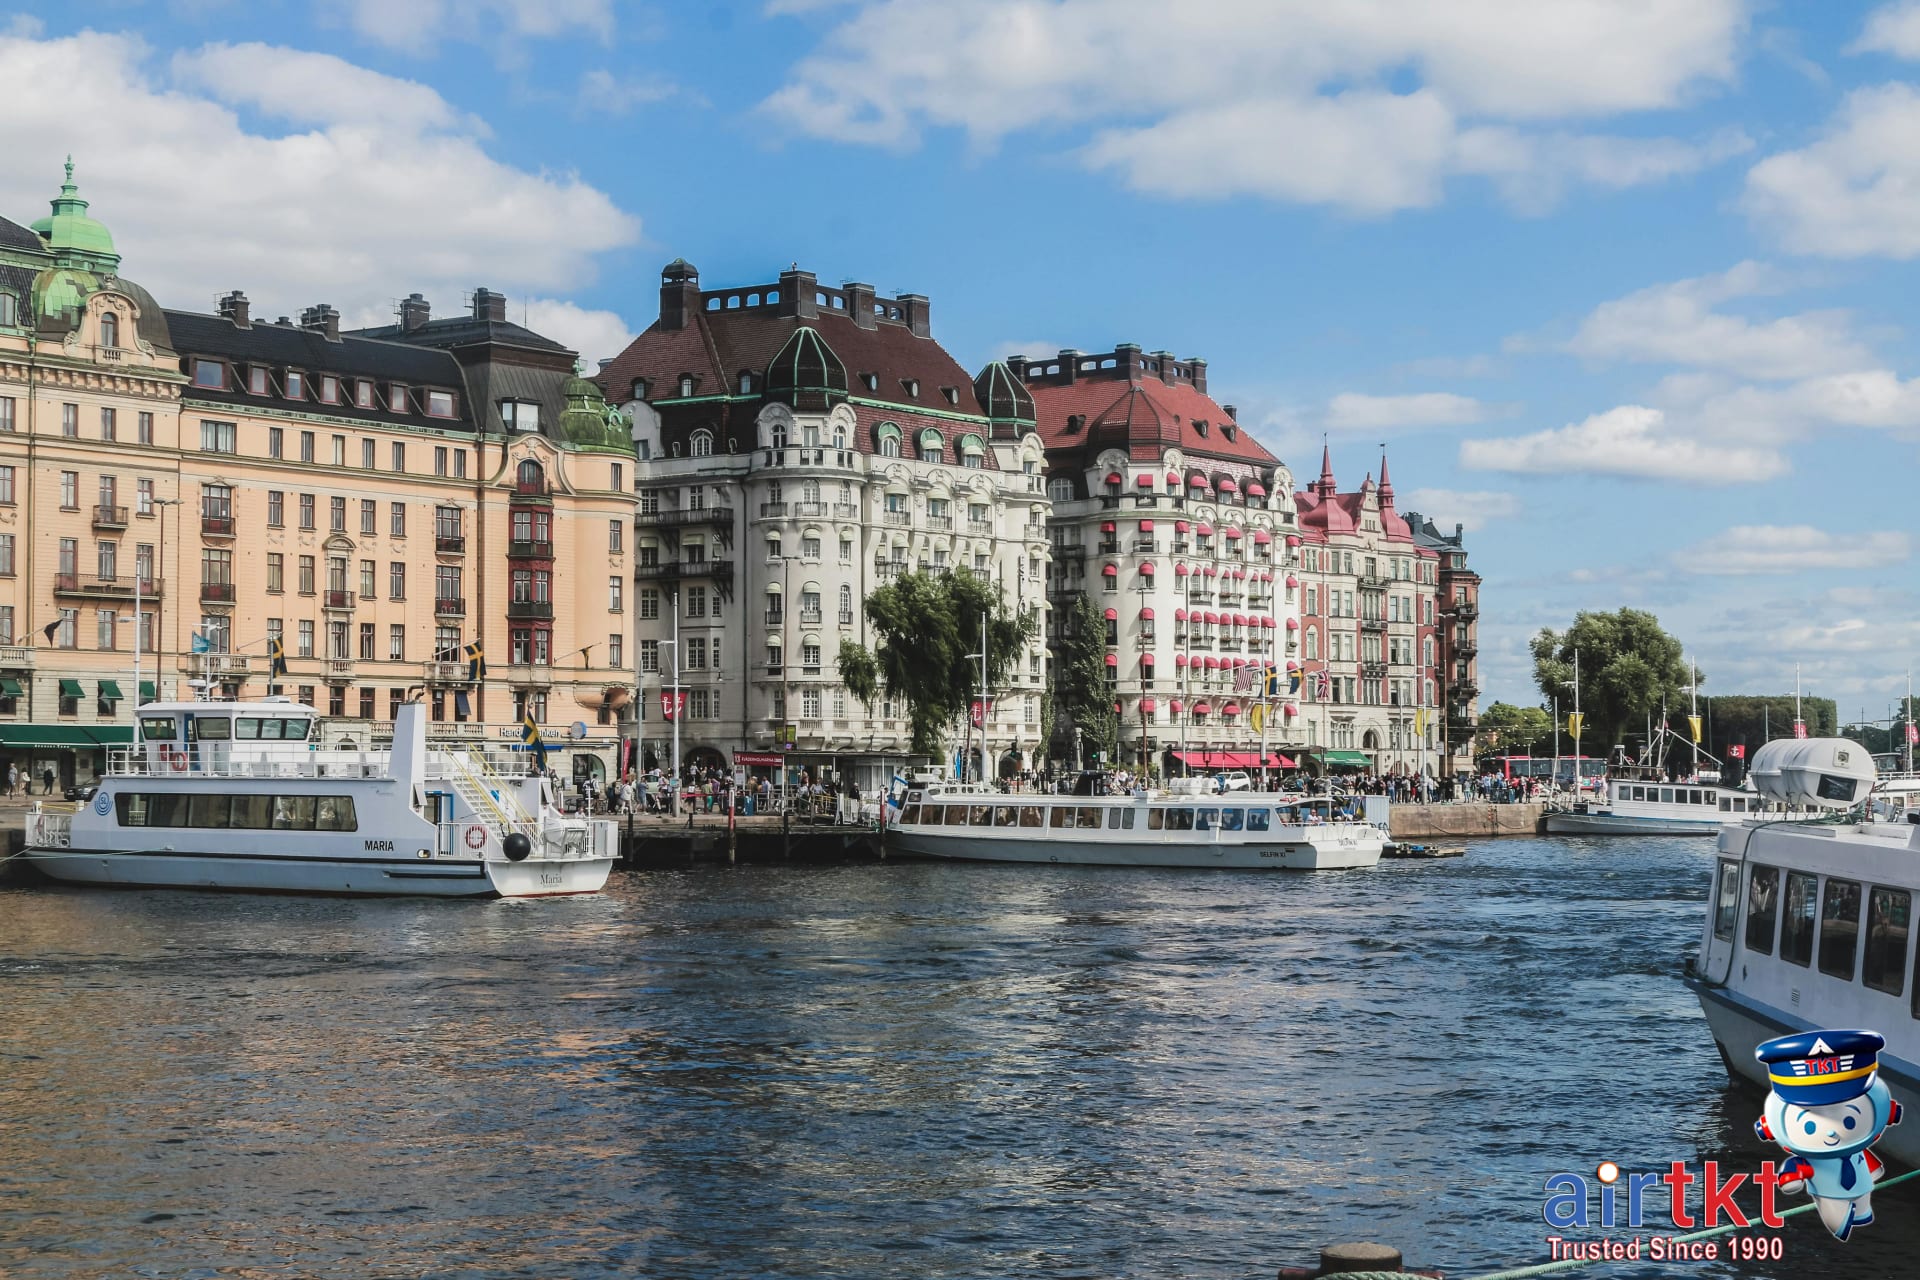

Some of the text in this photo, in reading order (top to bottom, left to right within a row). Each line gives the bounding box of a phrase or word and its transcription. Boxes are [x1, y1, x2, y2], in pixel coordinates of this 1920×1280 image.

[499, 727, 561, 738] Handnken
[364, 840, 394, 851] MARIA
[540, 873, 563, 885] Maria
